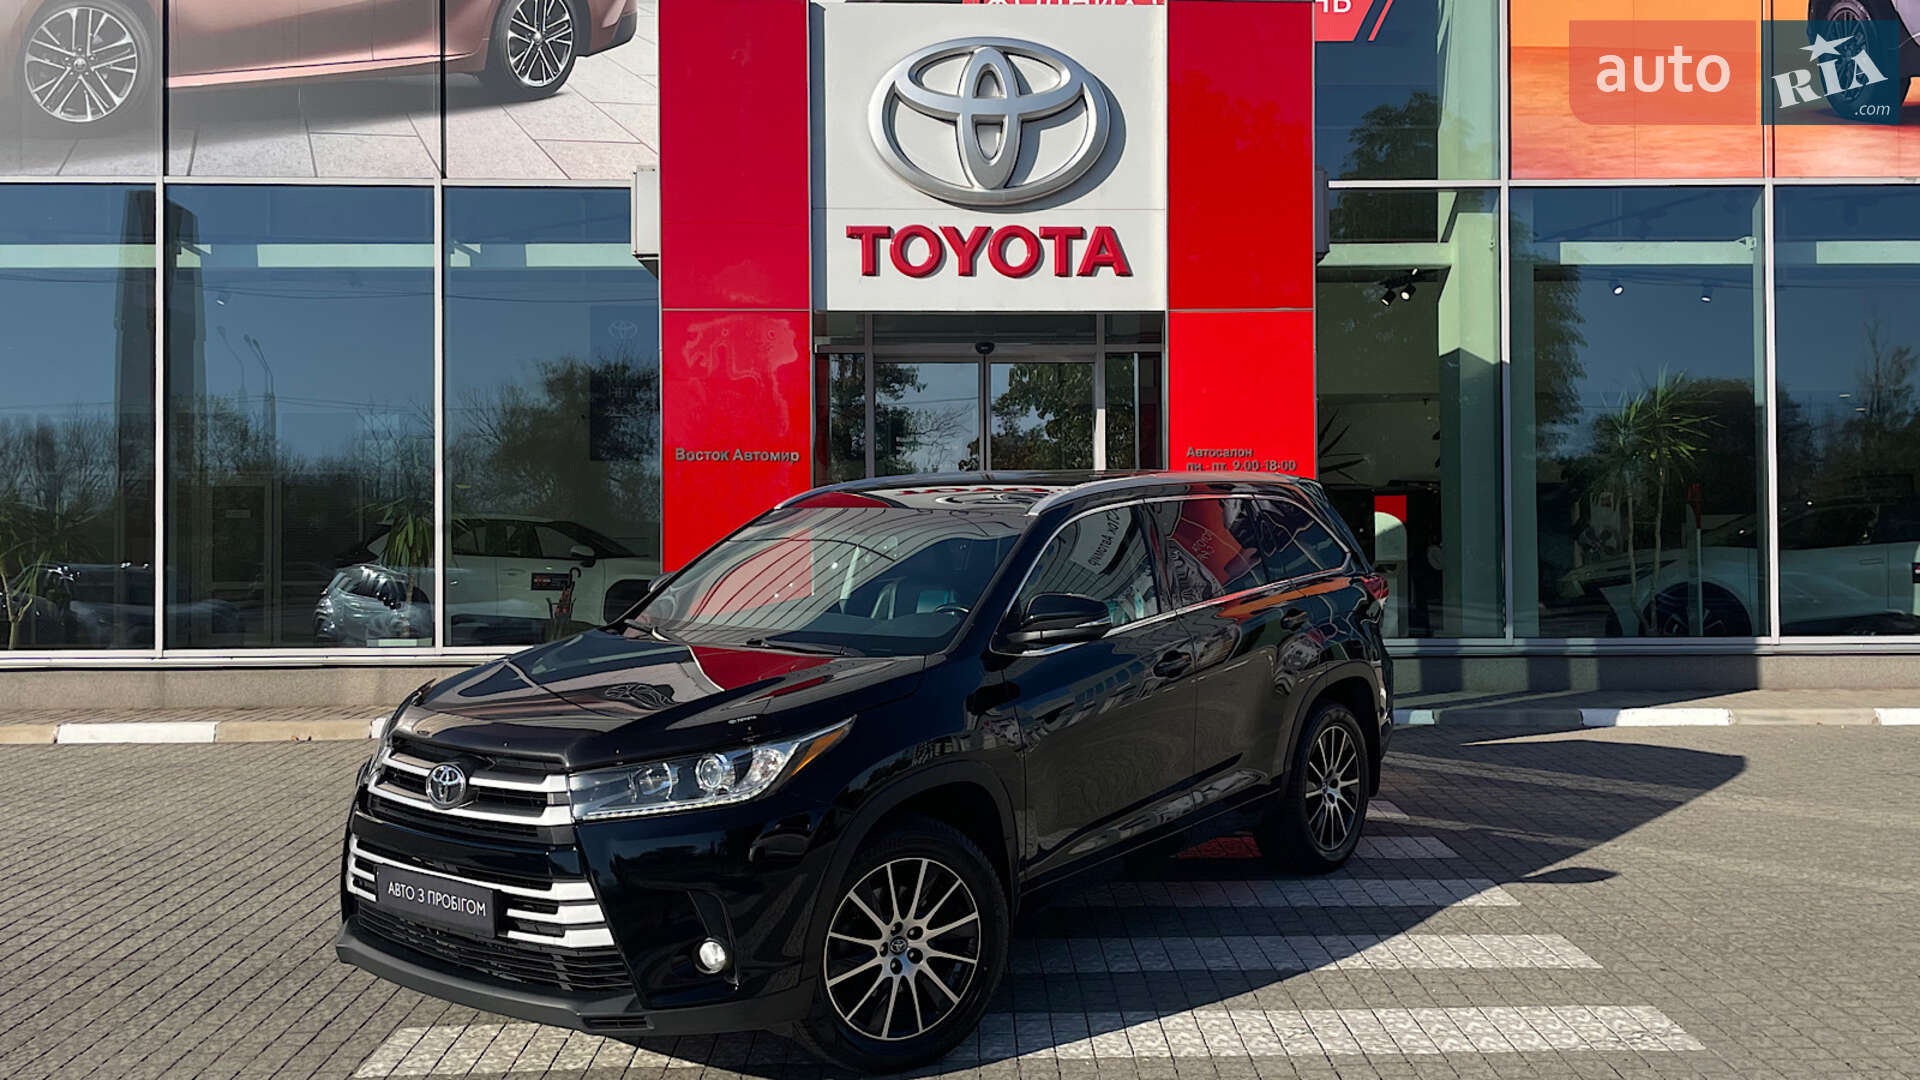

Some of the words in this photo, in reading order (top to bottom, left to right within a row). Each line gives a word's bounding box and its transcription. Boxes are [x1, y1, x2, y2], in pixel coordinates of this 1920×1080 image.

[846, 224, 1132, 279] TOYOTA
[675, 447, 730, 461] Восток
[732, 448, 800, 466] Автомир
[1186, 446, 1253, 458] Автосалон
[388, 881, 415, 901] АВТО
[427, 890, 486, 917] ПРОБІГОМ
